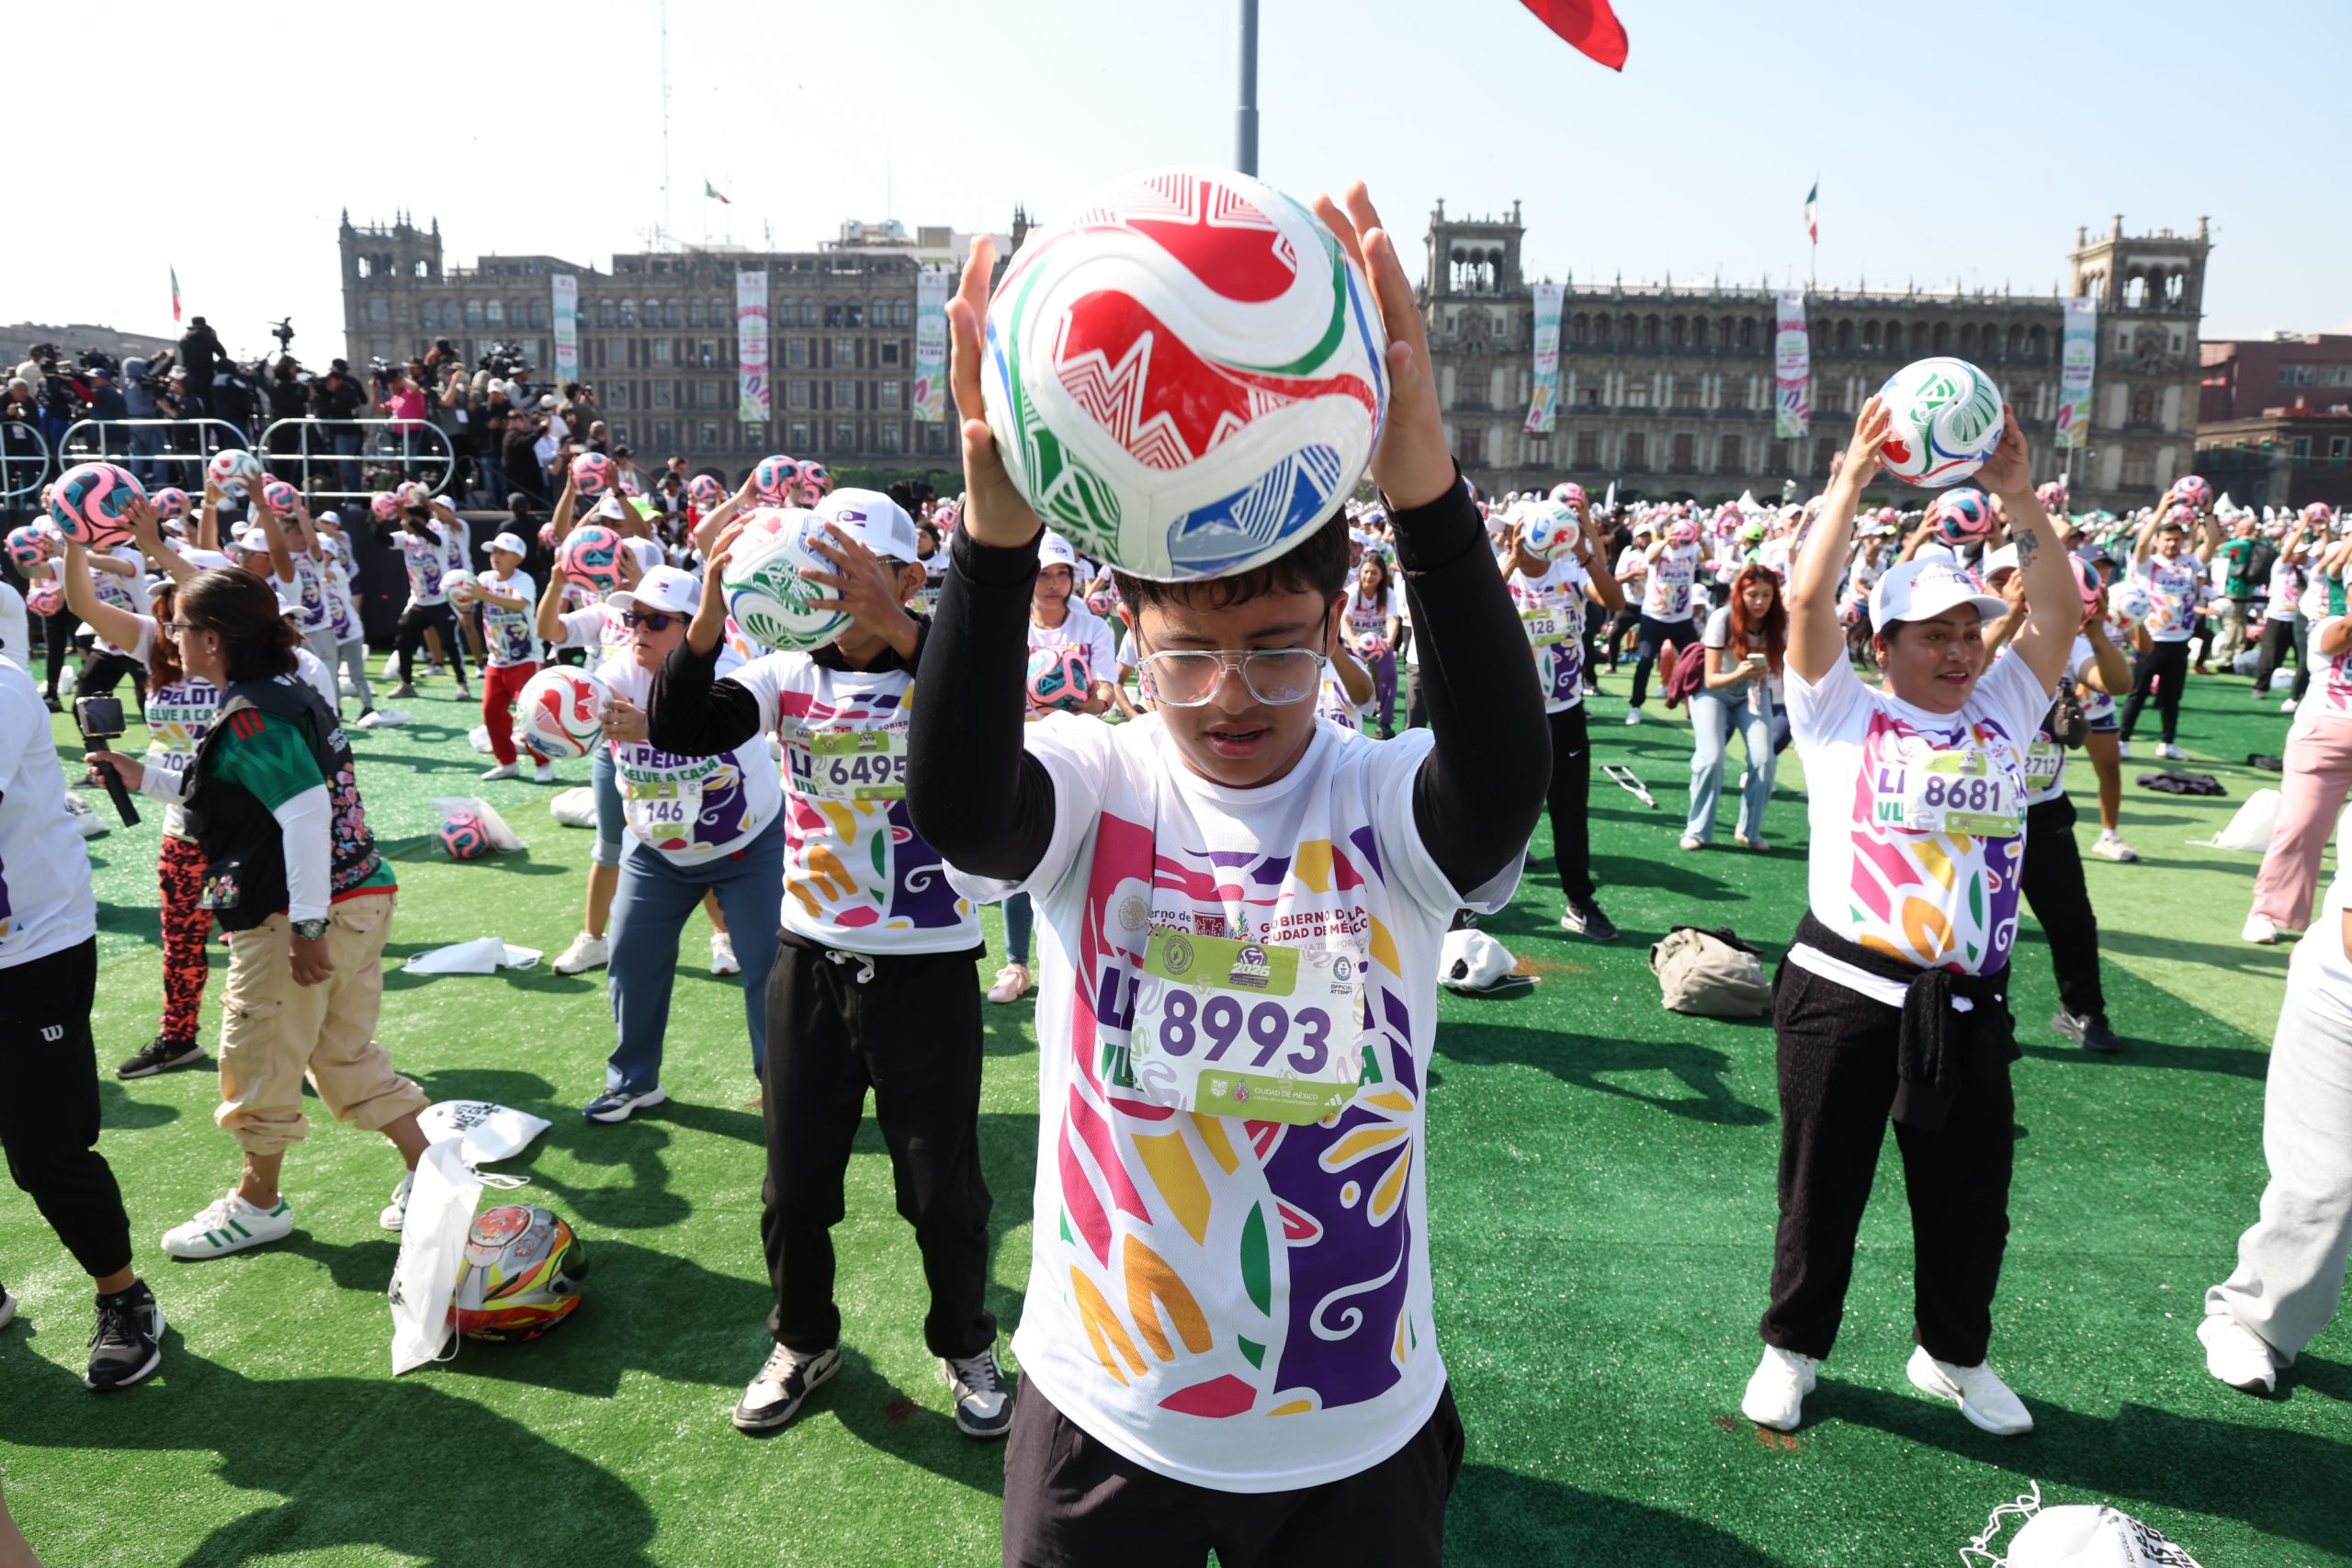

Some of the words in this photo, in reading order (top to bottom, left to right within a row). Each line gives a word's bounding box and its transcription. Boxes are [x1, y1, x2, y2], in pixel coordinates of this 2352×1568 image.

[1529, 620, 1555, 634] 128
[157, 687, 217, 705] PELOT
[665, 773, 677, 783] A
[679, 758, 718, 781] CASA
[830, 755, 907, 785] 6495
[2025, 757, 2055, 775] 2712
[1926, 776, 2000, 812] 8681
[646, 801, 684, 821] 146
[1179, 911, 1191, 921] de
[1260, 910, 1330, 933] GOBIERNO
[1347, 905, 1365, 921] LA
[1231, 962, 1271, 976] 2026
[1159, 989, 1331, 1074] 8993
[1254, 1088, 1281, 1097] CIUDAD
